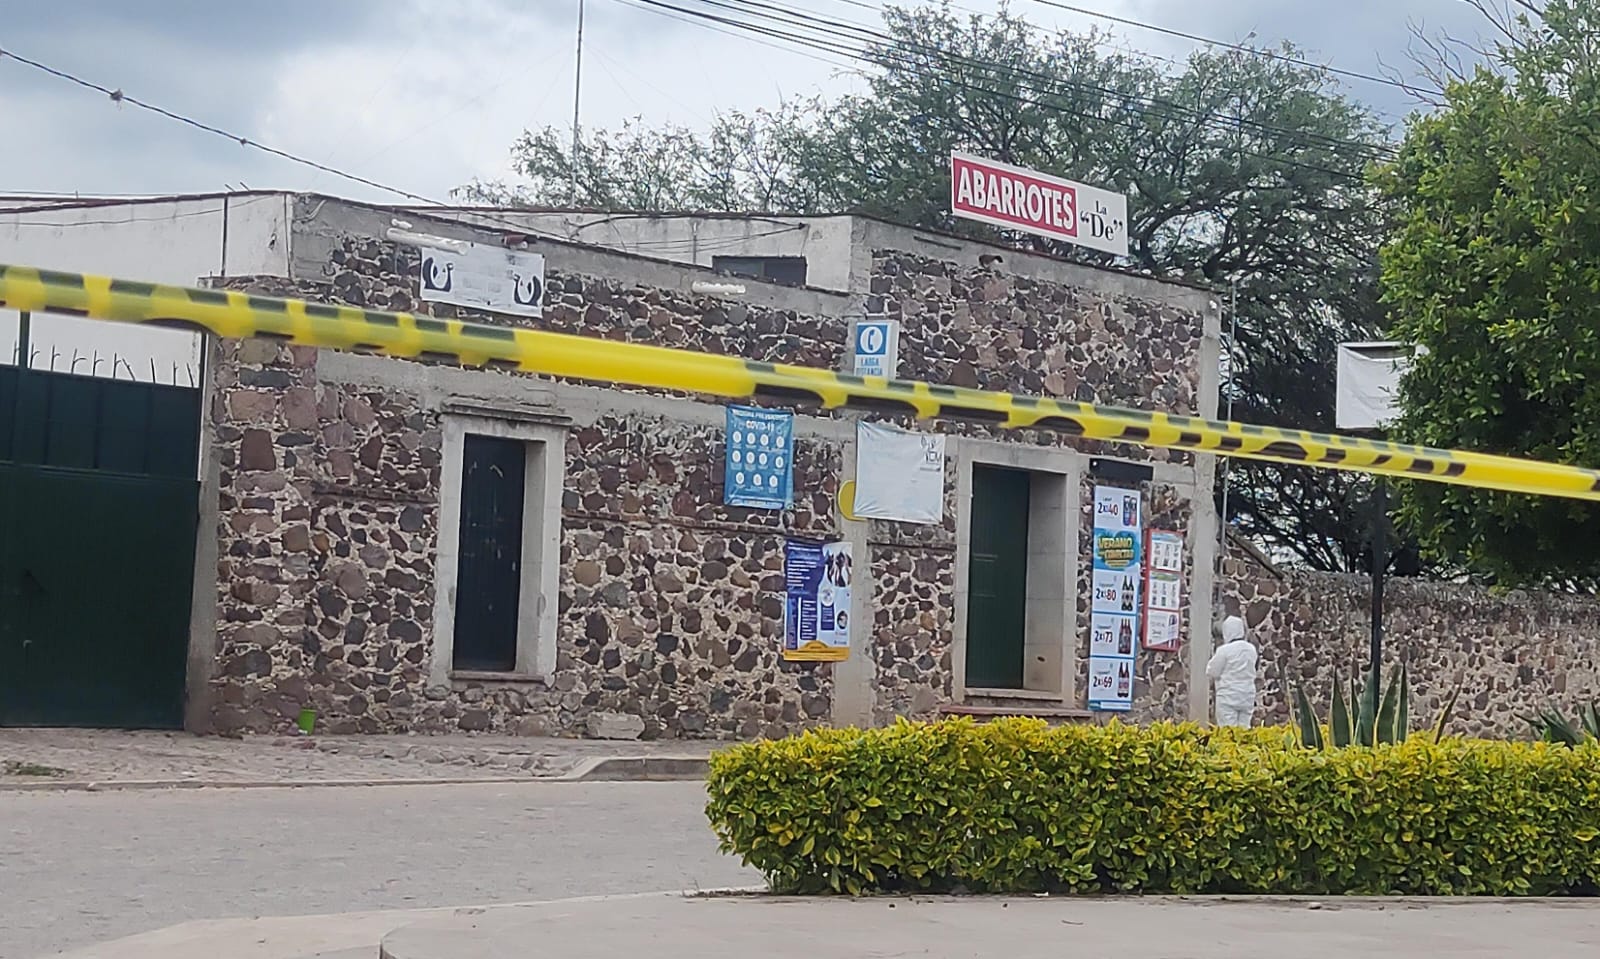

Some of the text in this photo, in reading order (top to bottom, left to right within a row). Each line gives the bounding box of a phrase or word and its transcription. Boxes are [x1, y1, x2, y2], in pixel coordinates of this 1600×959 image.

[957, 166, 1075, 231] ABARROTES
[1095, 200, 1108, 215] La
[1098, 536, 1133, 549] VERANO
